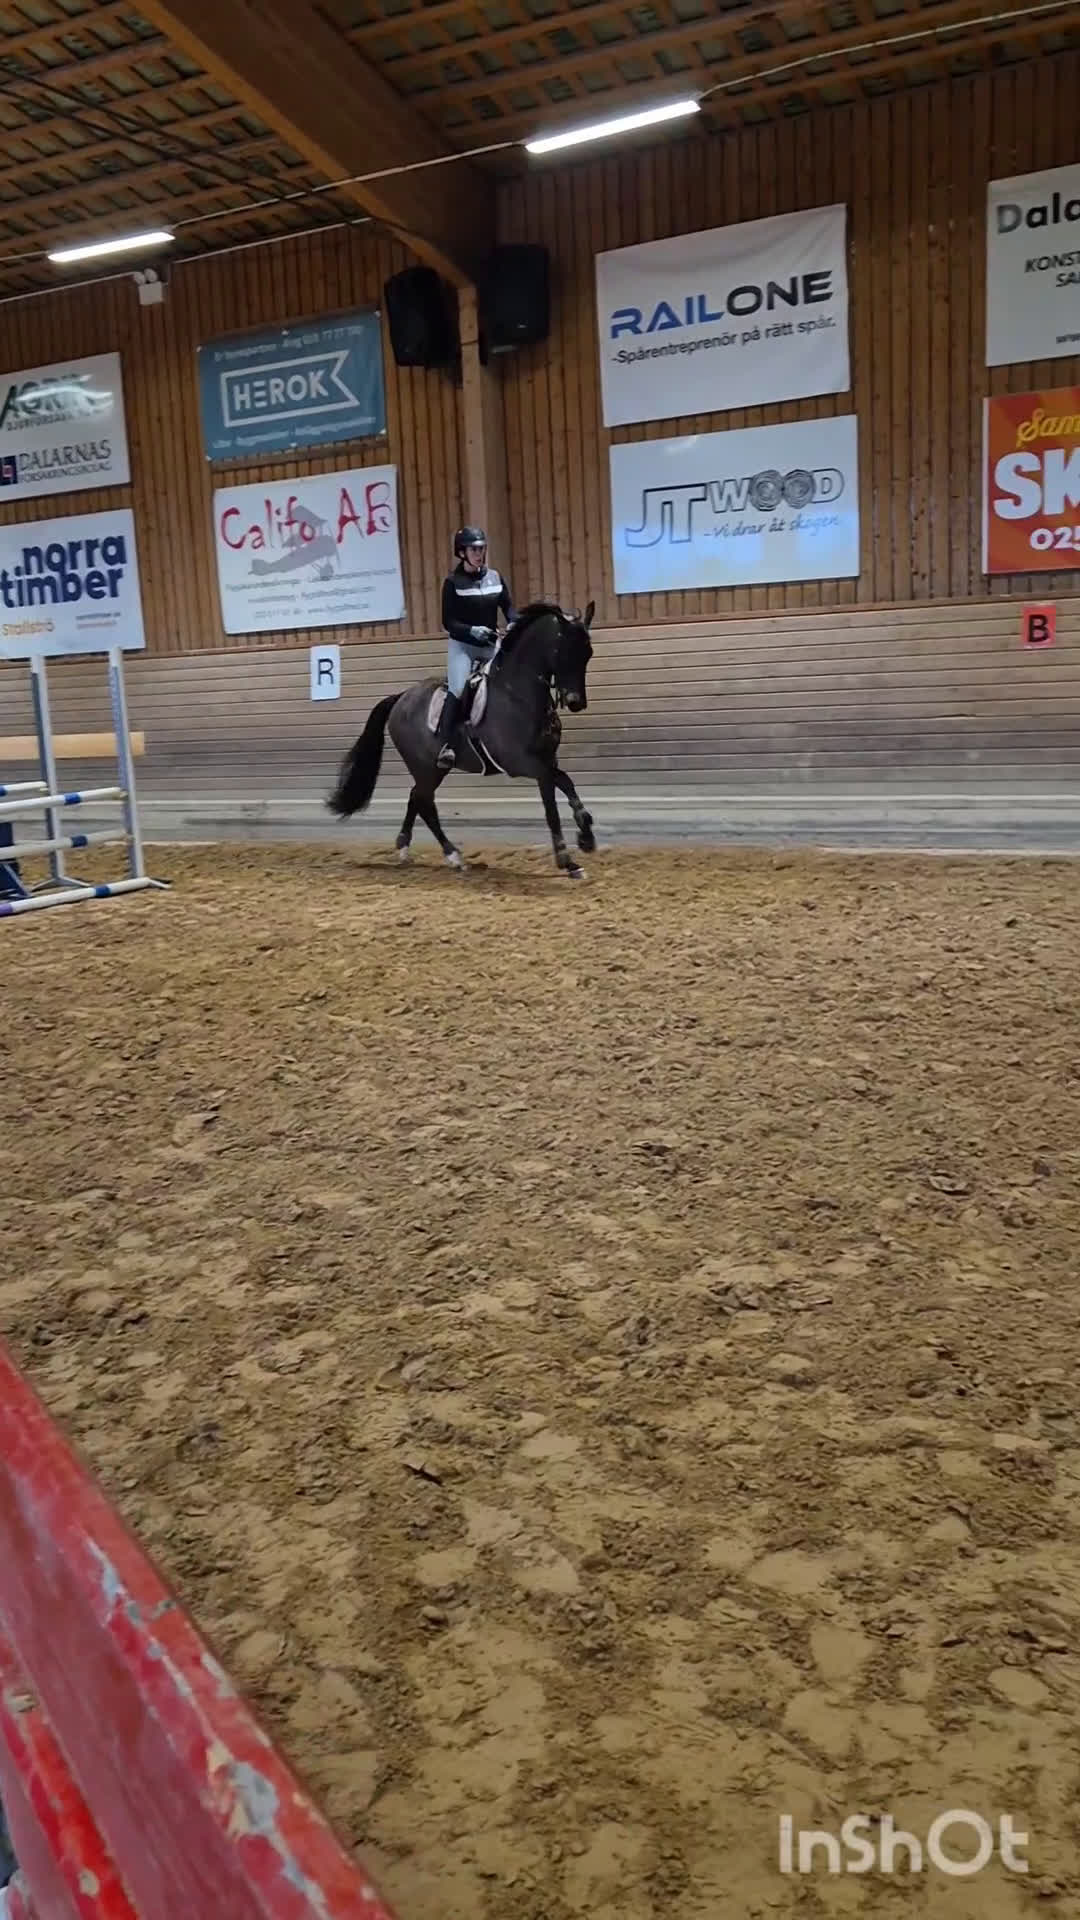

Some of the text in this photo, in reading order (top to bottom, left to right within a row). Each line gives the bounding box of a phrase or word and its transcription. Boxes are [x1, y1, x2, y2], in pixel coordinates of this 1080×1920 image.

[611, 270, 833, 339] RAILONE
[742, 327, 761, 345] på
[764, 322, 794, 339] rätt
[233, 369, 329, 412] HEROK
[19, 439, 111, 471] DALARNAS
[337, 481, 392, 544] AB
[22, 535, 127, 575] norra
[0, 566, 124, 608] timber
[1027, 614, 1049, 643] B
[317, 658, 335, 686] R
